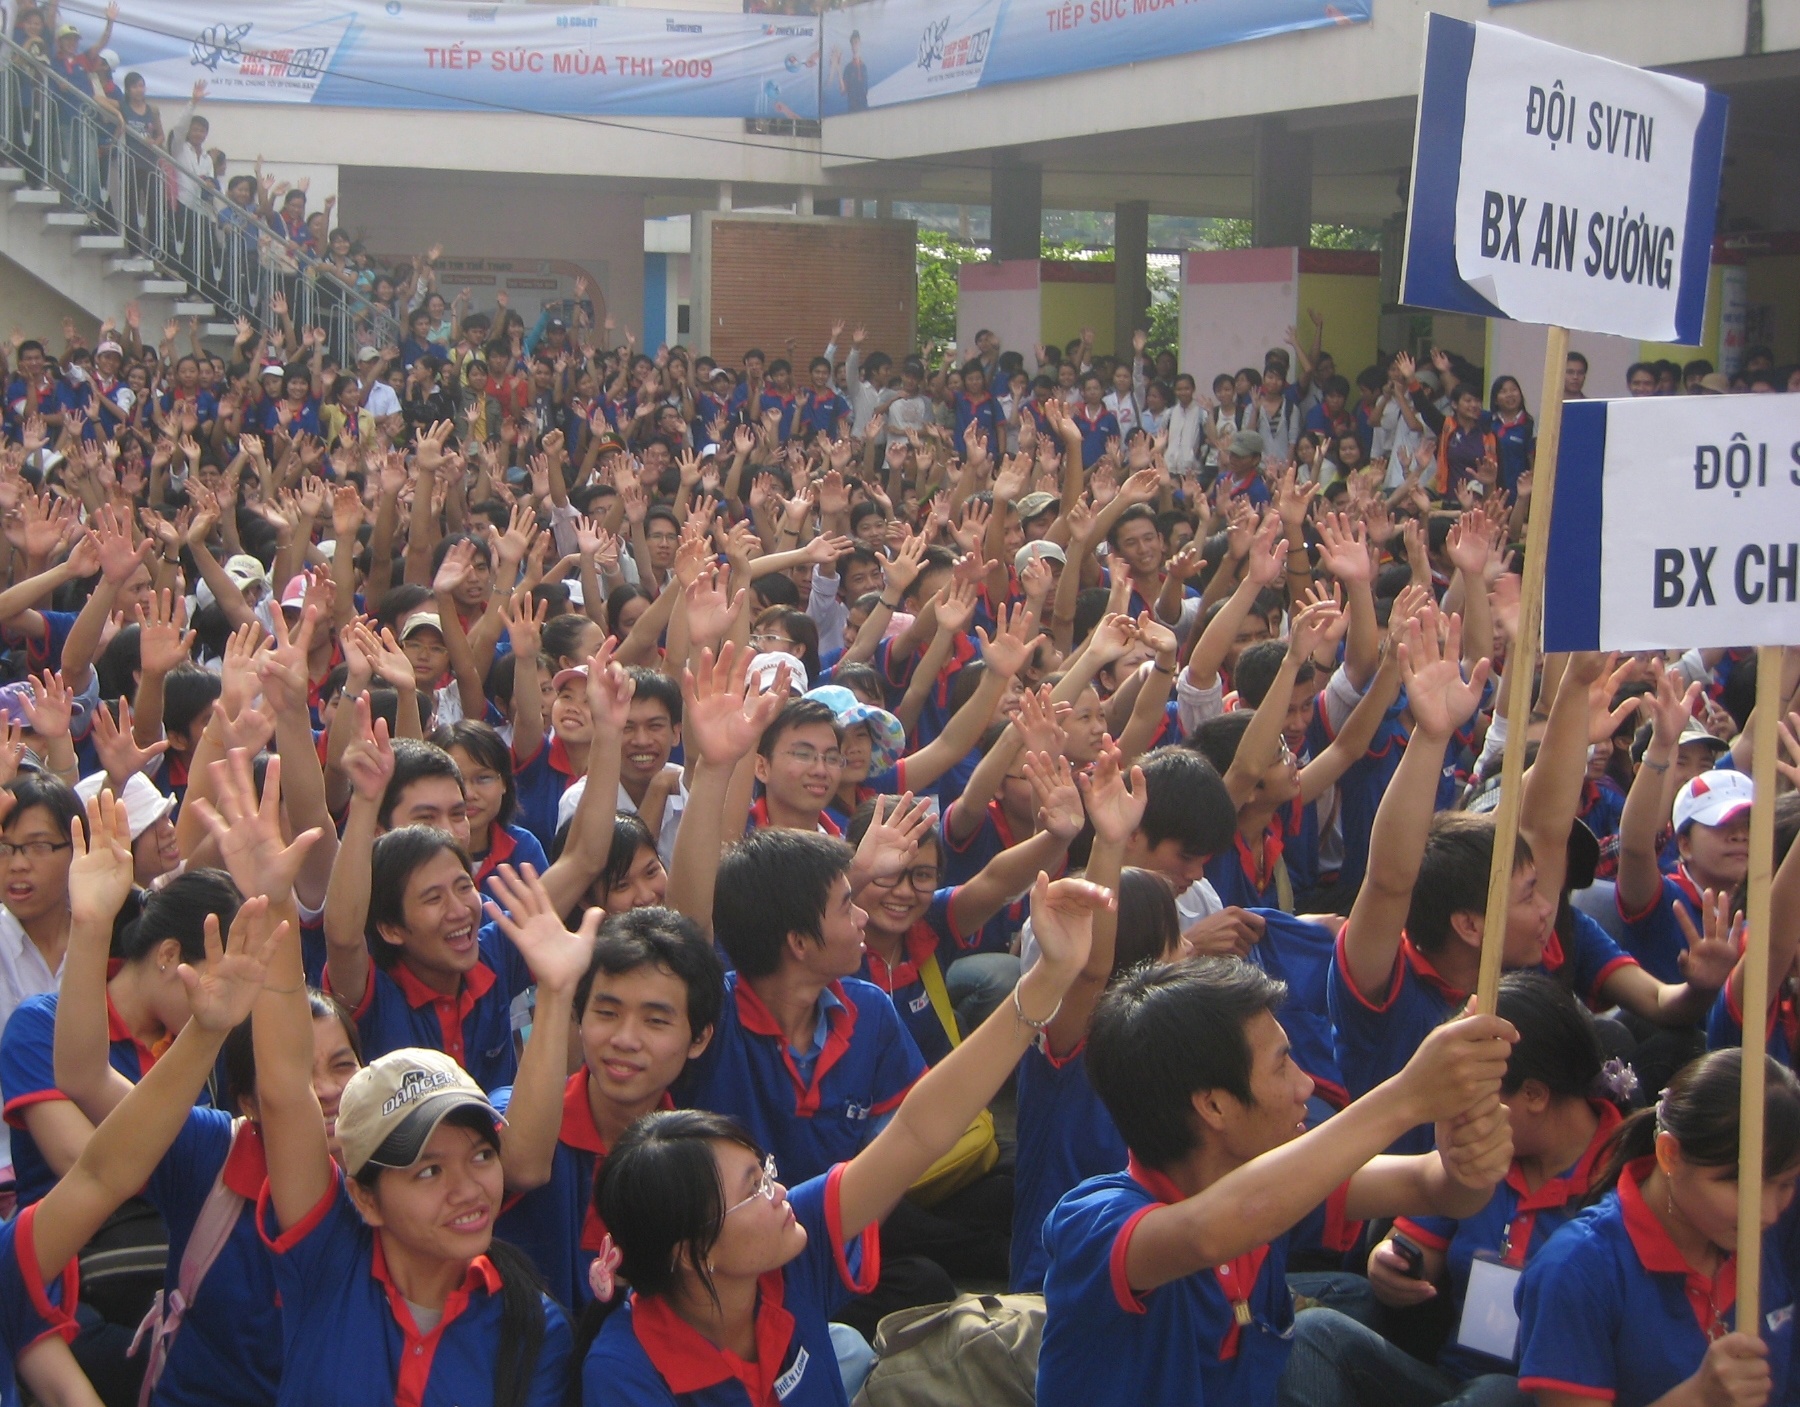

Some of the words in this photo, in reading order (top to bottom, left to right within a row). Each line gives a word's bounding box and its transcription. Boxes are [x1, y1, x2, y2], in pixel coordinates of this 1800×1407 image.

[424, 40, 483, 70] TIẾP
[490, 46, 544, 73] SỨC
[552, 48, 607, 76] MÙA
[615, 55, 654, 77] THI
[660, 58, 713, 79] 2009
[1526, 79, 1576, 151] ĐỘI
[1586, 101, 1654, 163] SVTN
[1480, 190, 1526, 263] BX
[1532, 203, 1578, 272] AN
[1584, 206, 1675, 290] SƯƠNG
[1694, 432, 1767, 498] ĐỘI
[1653, 546, 1717, 609] BX
[382, 1071, 457, 1116] DANCER
